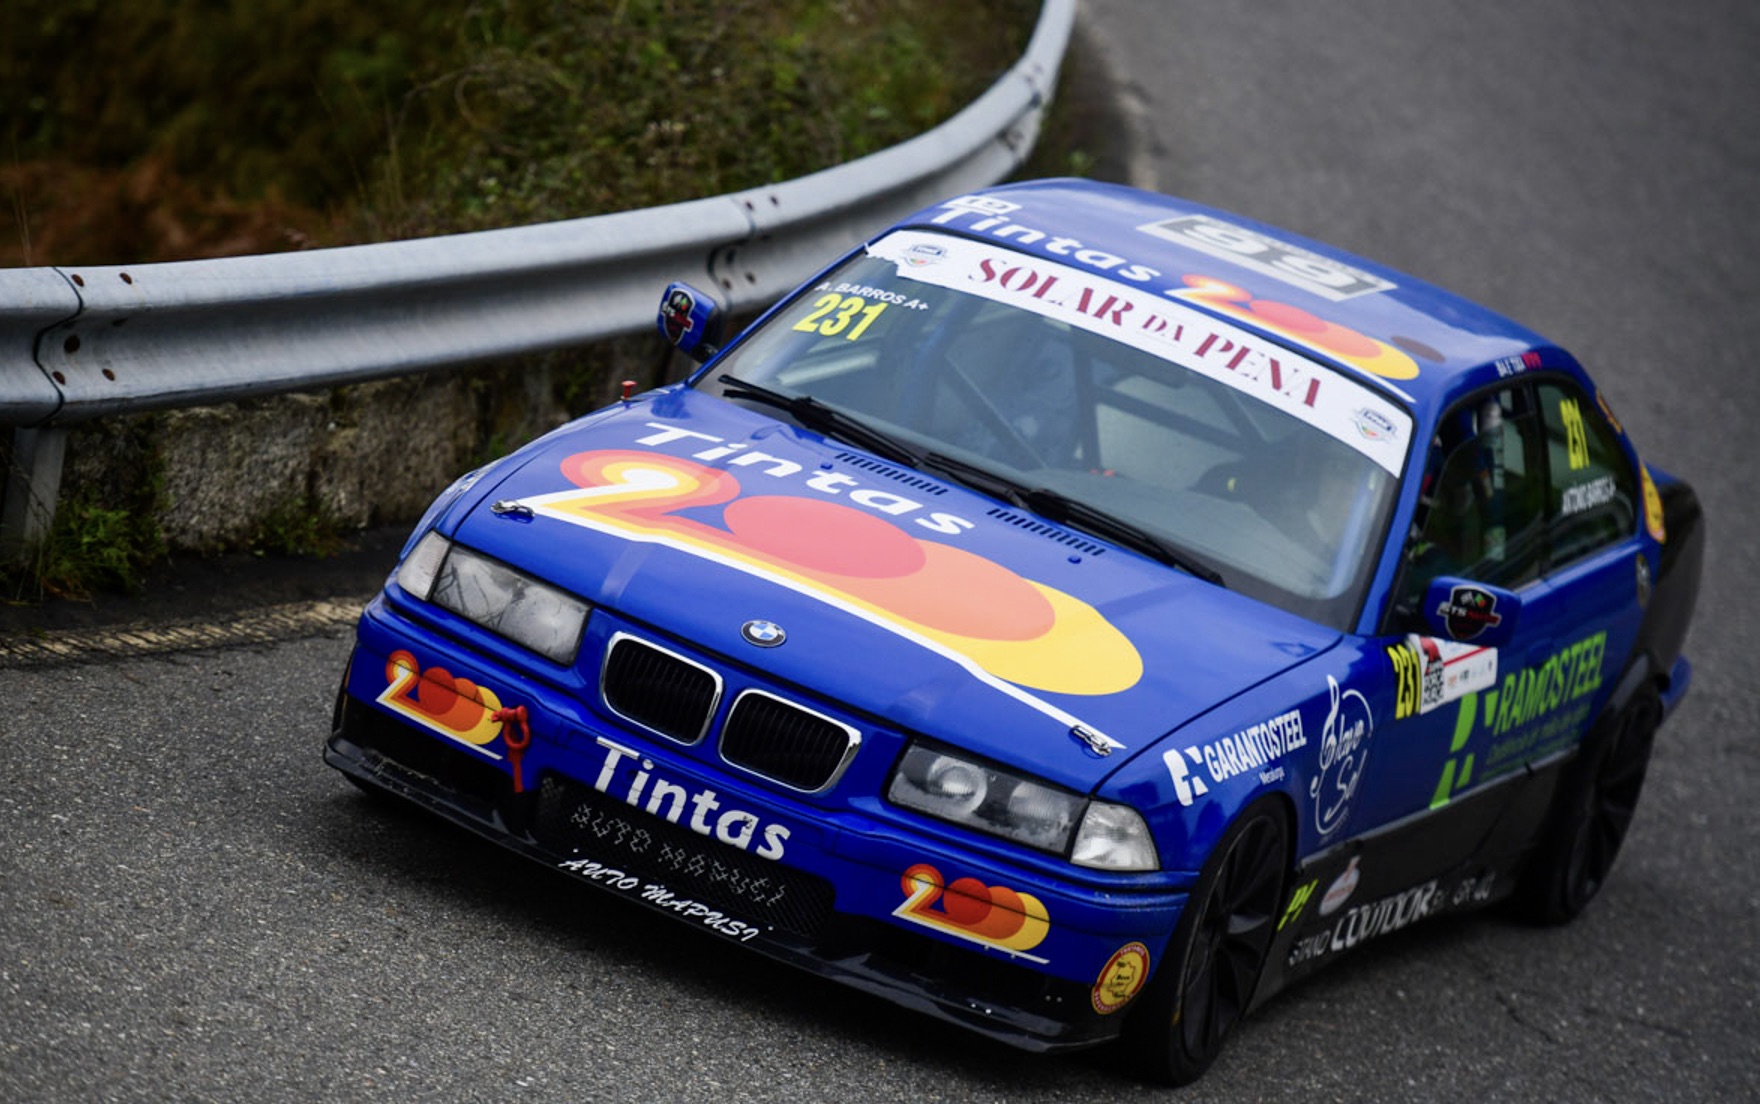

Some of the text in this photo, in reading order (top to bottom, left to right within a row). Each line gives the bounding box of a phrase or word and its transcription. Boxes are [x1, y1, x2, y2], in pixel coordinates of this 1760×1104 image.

[931, 204, 1162, 282] Tintas
[791, 293, 888, 341] 231
[834, 282, 907, 305] BARROS
[968, 257, 1321, 408] SOLAR DA PENA
[635, 421, 976, 537] Tintas
[1387, 642, 1421, 720] 231
[1203, 709, 1307, 783] GARANTOSTEEL
[594, 736, 791, 861] Tintas
[558, 858, 639, 890] AUTO
